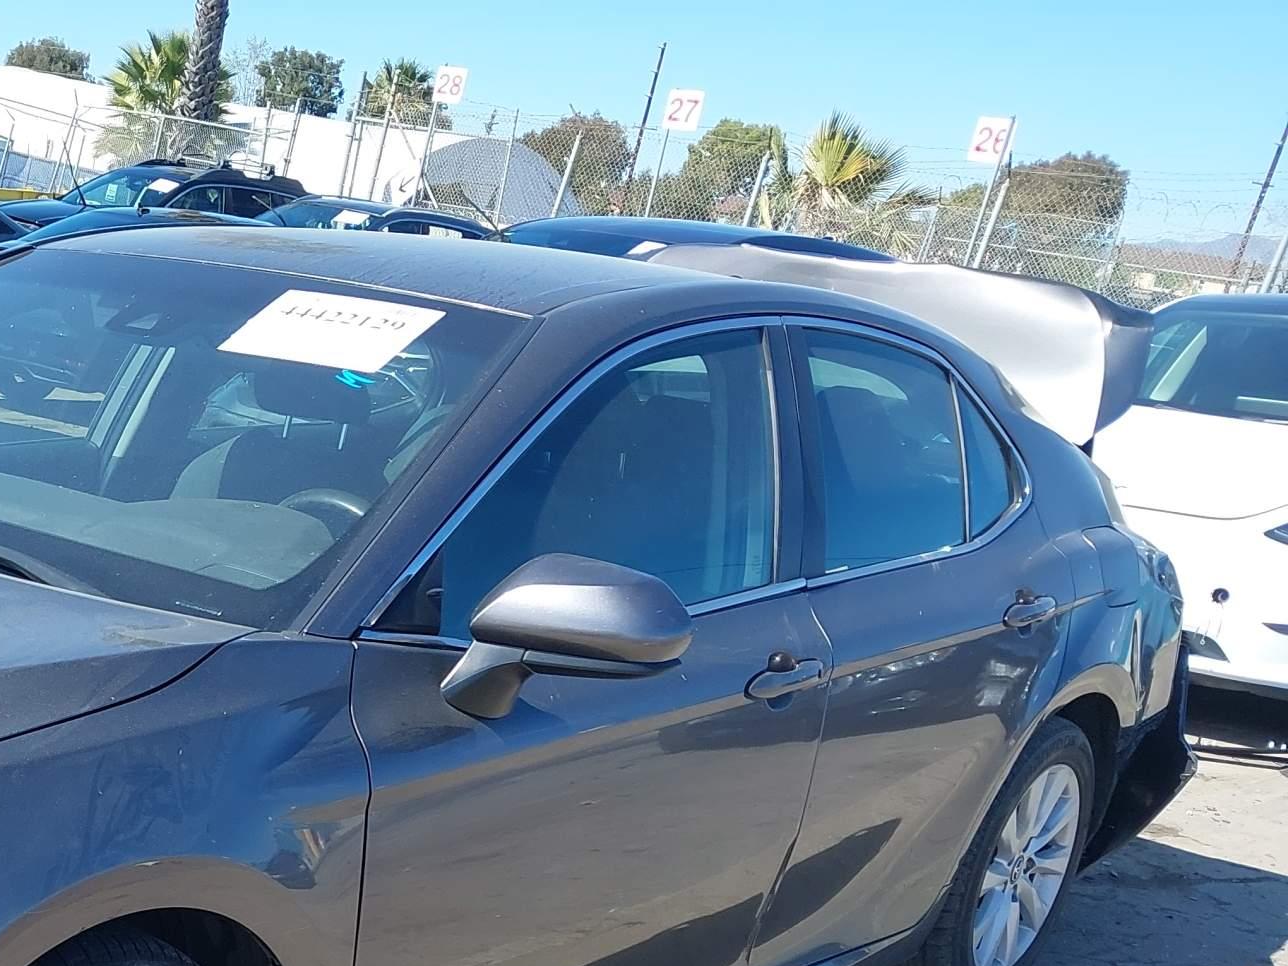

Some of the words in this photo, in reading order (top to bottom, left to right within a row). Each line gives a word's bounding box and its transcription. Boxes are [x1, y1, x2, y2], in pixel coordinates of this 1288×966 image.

[437, 73, 463, 96] 28
[668, 98, 699, 122] 27
[280, 305, 407, 331] 44422129
